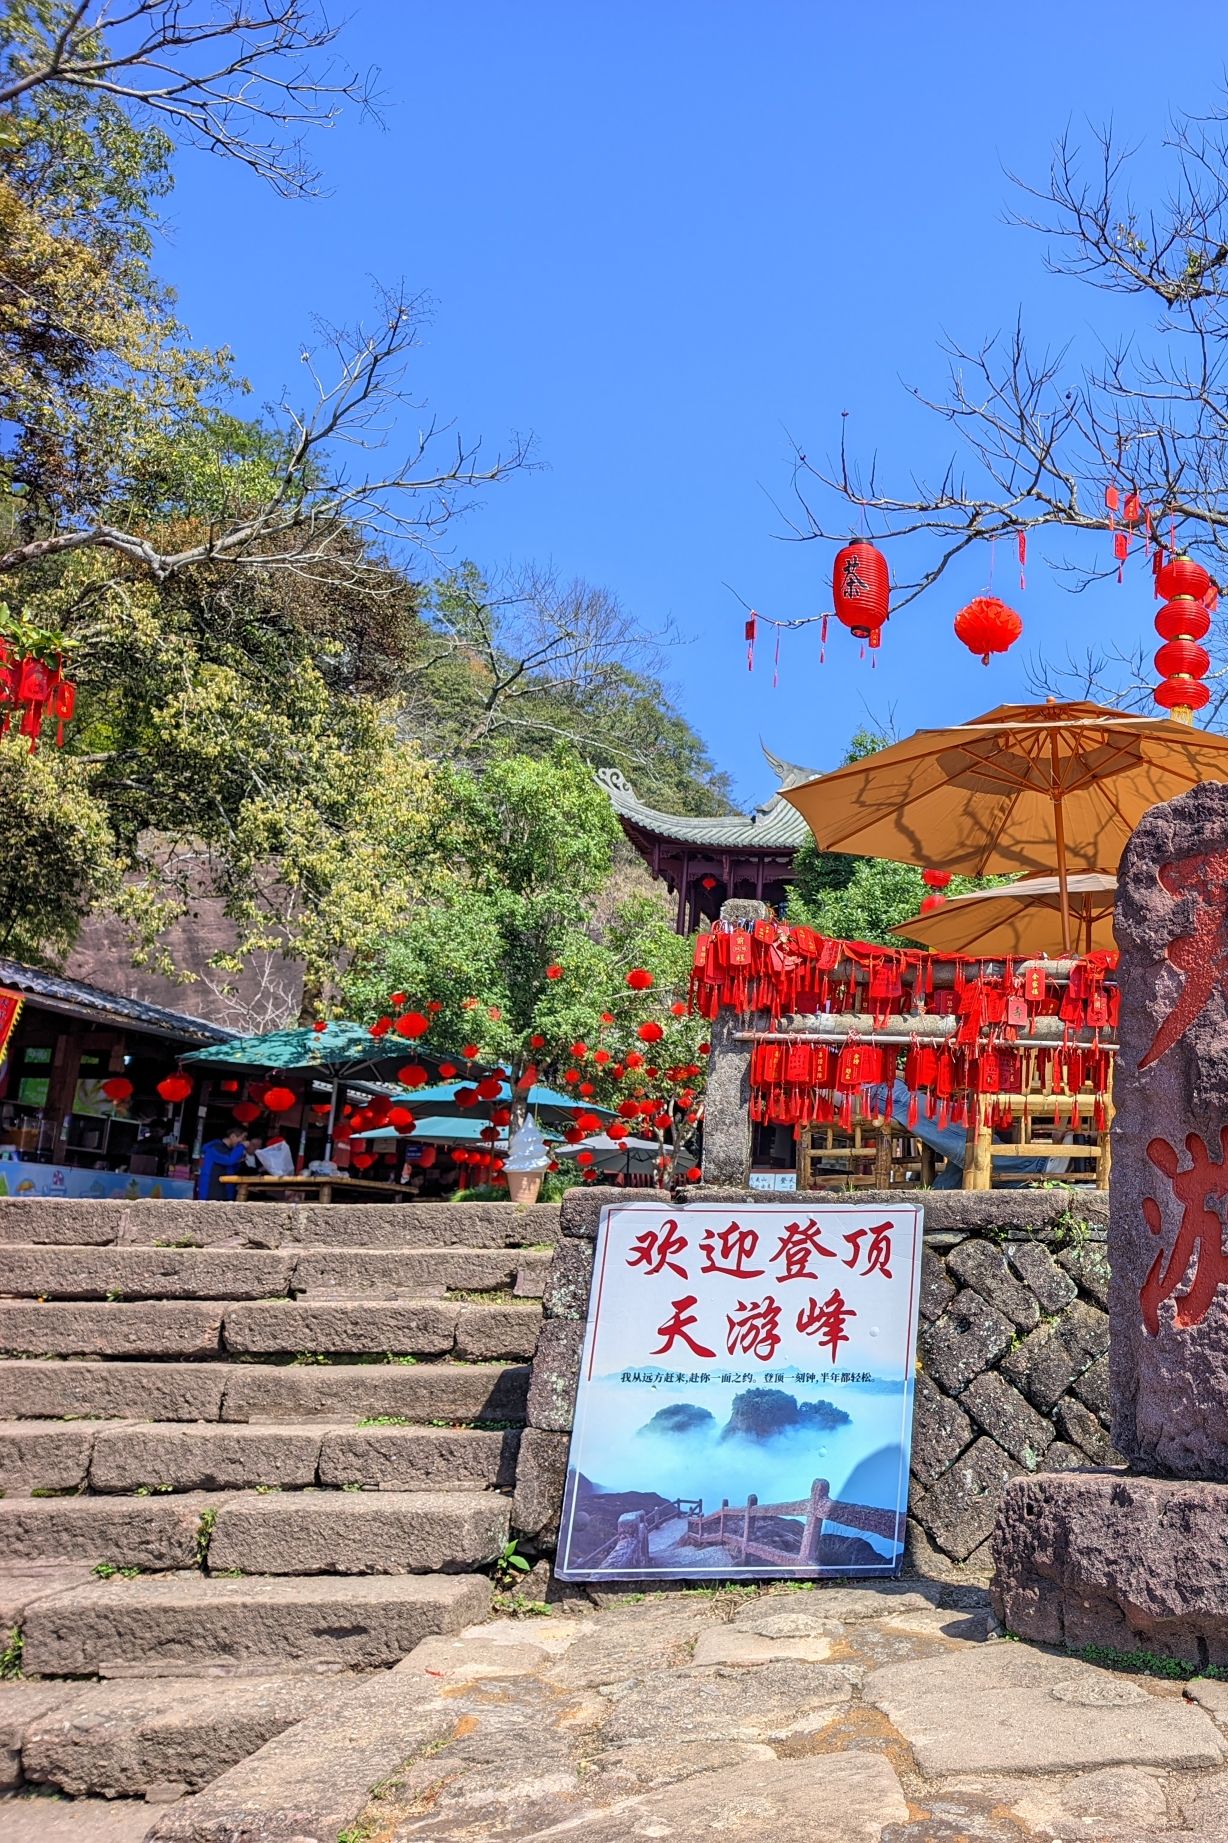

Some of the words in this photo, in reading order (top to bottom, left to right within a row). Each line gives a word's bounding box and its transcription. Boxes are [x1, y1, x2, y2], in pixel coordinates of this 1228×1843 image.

[841, 555, 869, 600] 茶
[625, 1218, 896, 1284] 欢迎登顶
[649, 1289, 857, 1364] 天游峰
